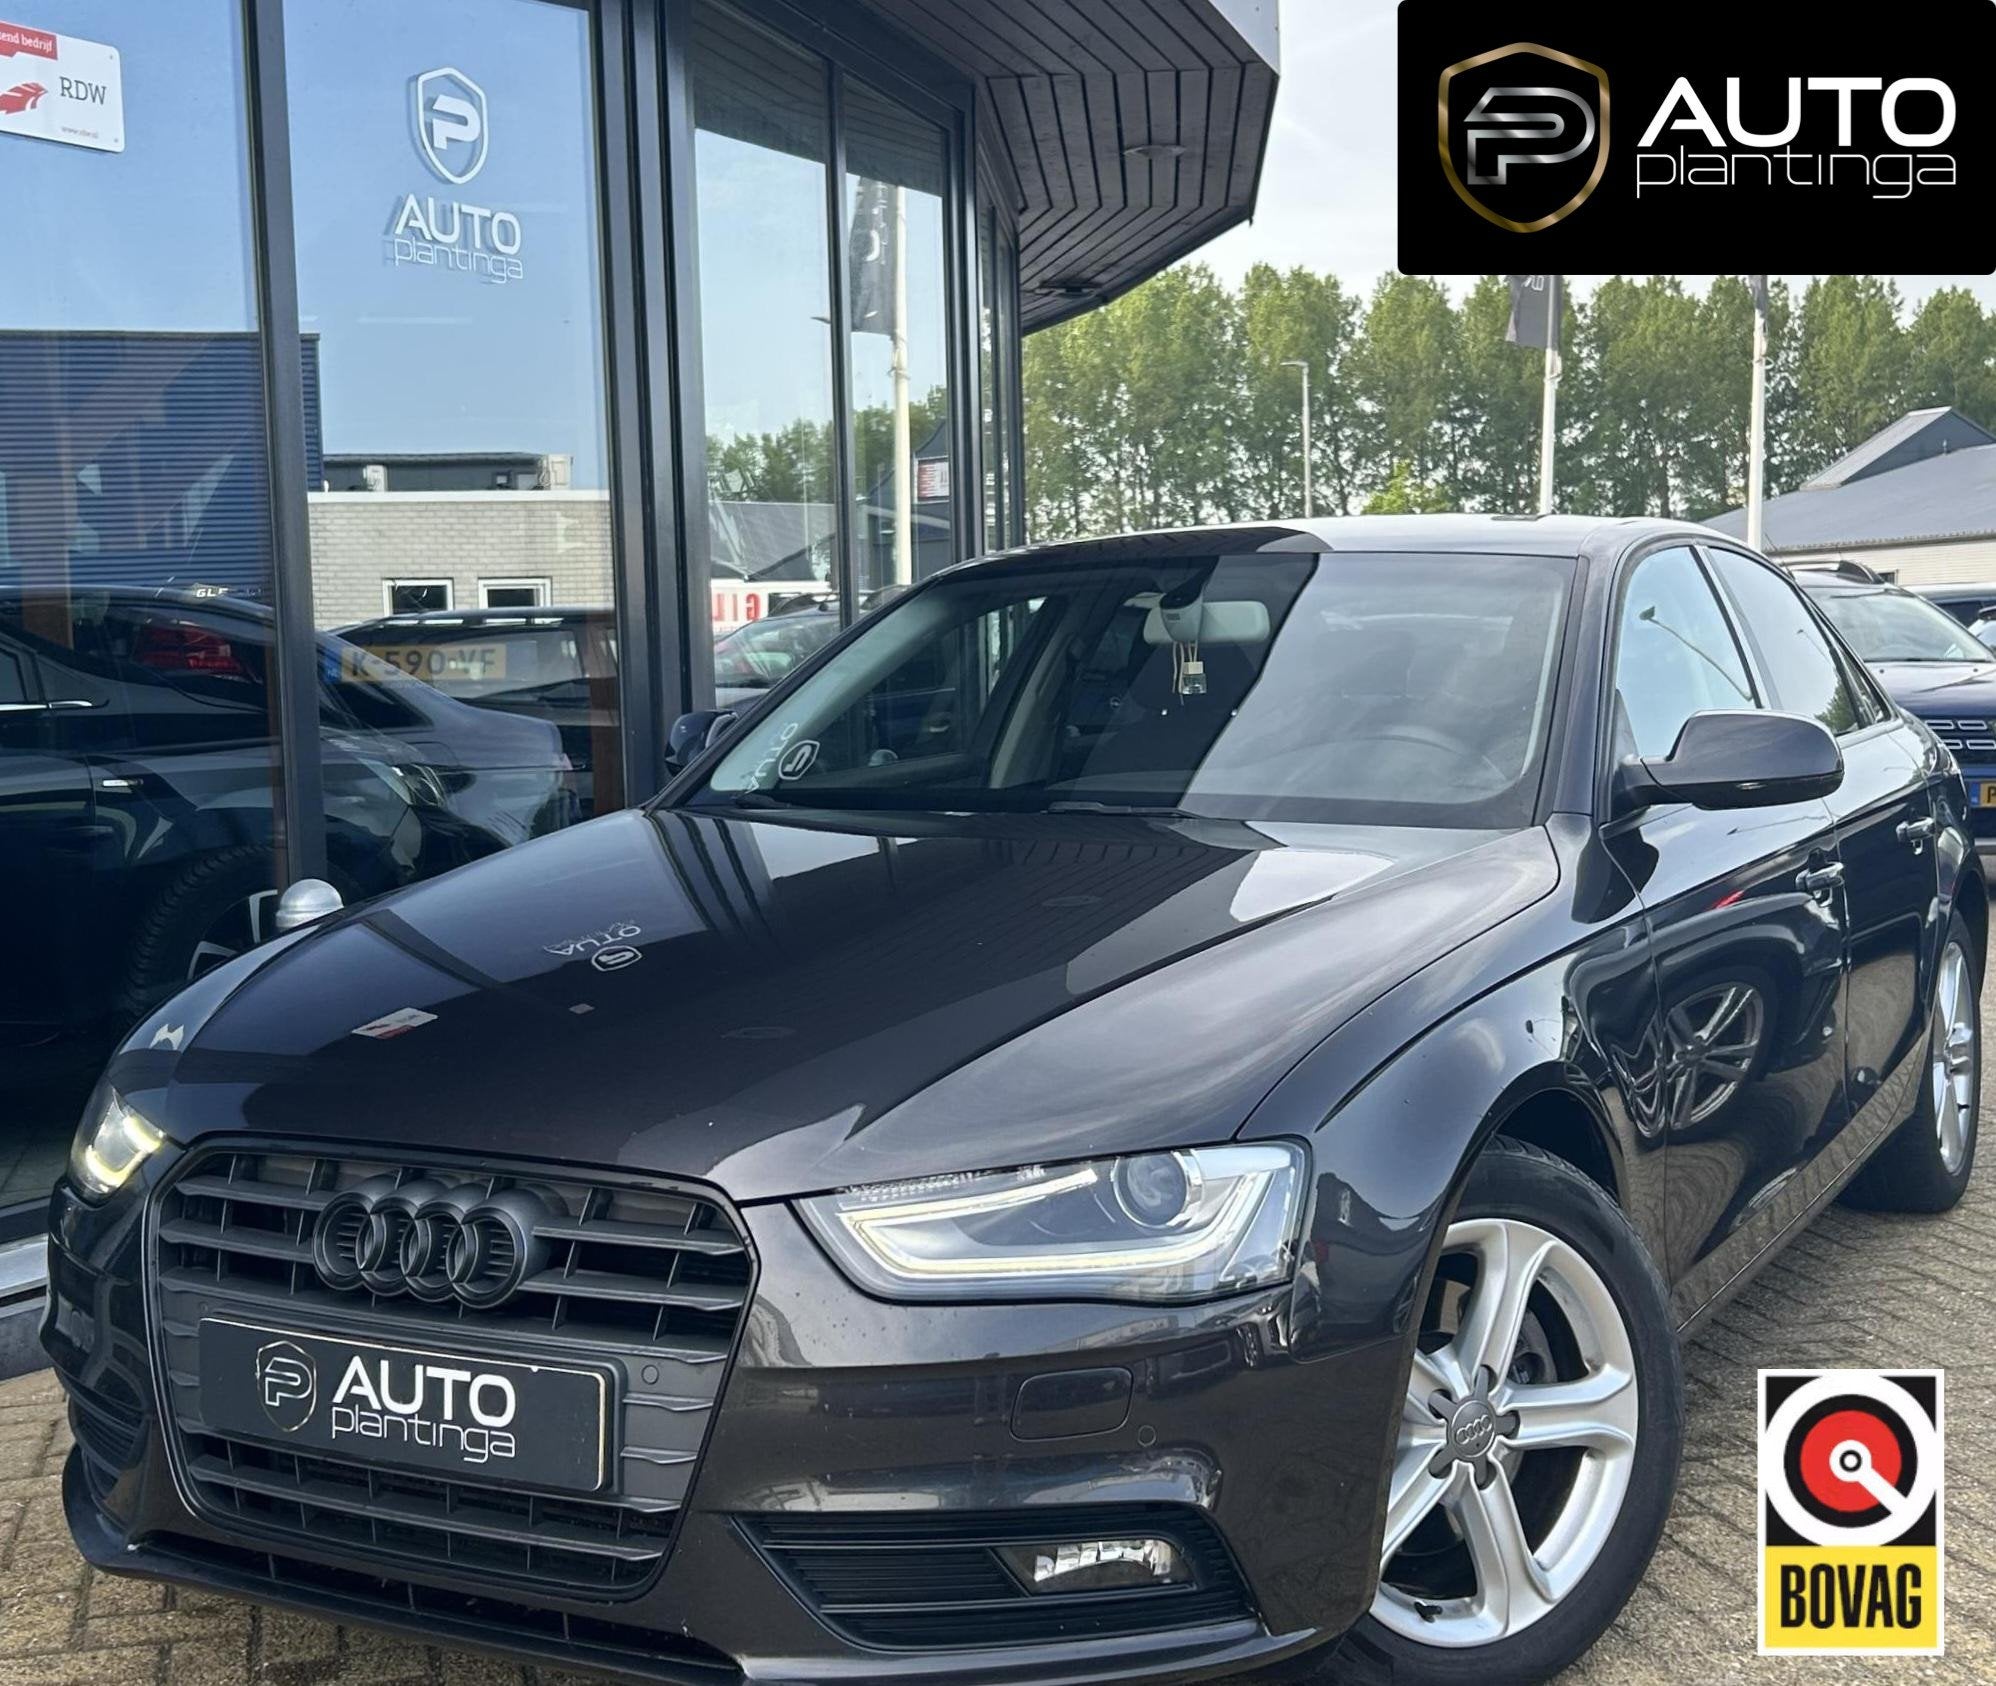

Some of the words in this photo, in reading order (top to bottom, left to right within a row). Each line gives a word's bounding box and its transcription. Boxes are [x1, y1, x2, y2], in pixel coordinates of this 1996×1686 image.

[21, 33, 53, 53] bedrijf
[59, 75, 108, 105] RDW
[395, 194, 522, 255] AUTO
[393, 235, 523, 284] plantinga
[332, 1355, 517, 1428] AUTO
[331, 1403, 516, 1464] plantinga
